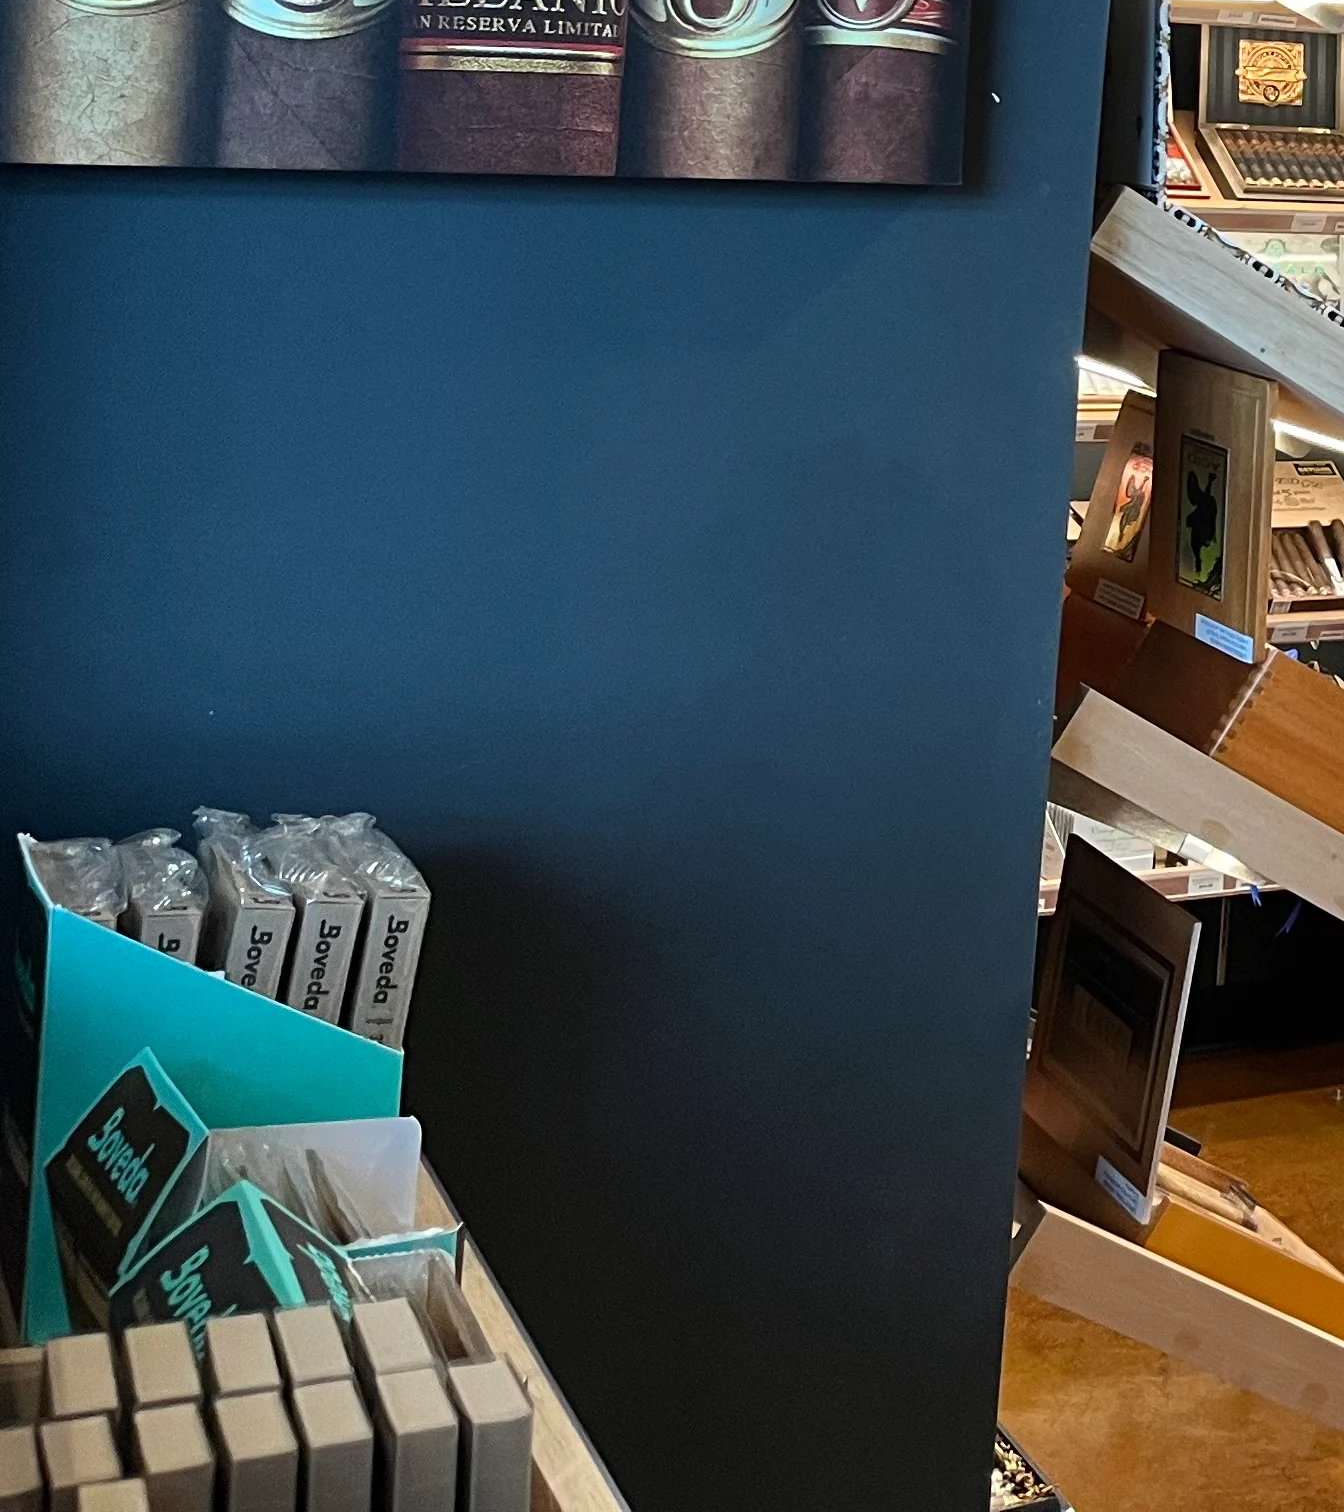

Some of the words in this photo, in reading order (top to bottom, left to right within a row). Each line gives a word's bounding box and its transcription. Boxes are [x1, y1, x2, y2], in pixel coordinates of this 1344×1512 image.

[438, 15, 536, 33] RESERVA
[544, 19, 620, 37] LIMITAD
[240, 926, 272, 988] Bove
[302, 919, 342, 1011] Boveda
[373, 914, 409, 1004] Boveda
[87, 1107, 155, 1206] Boveda
